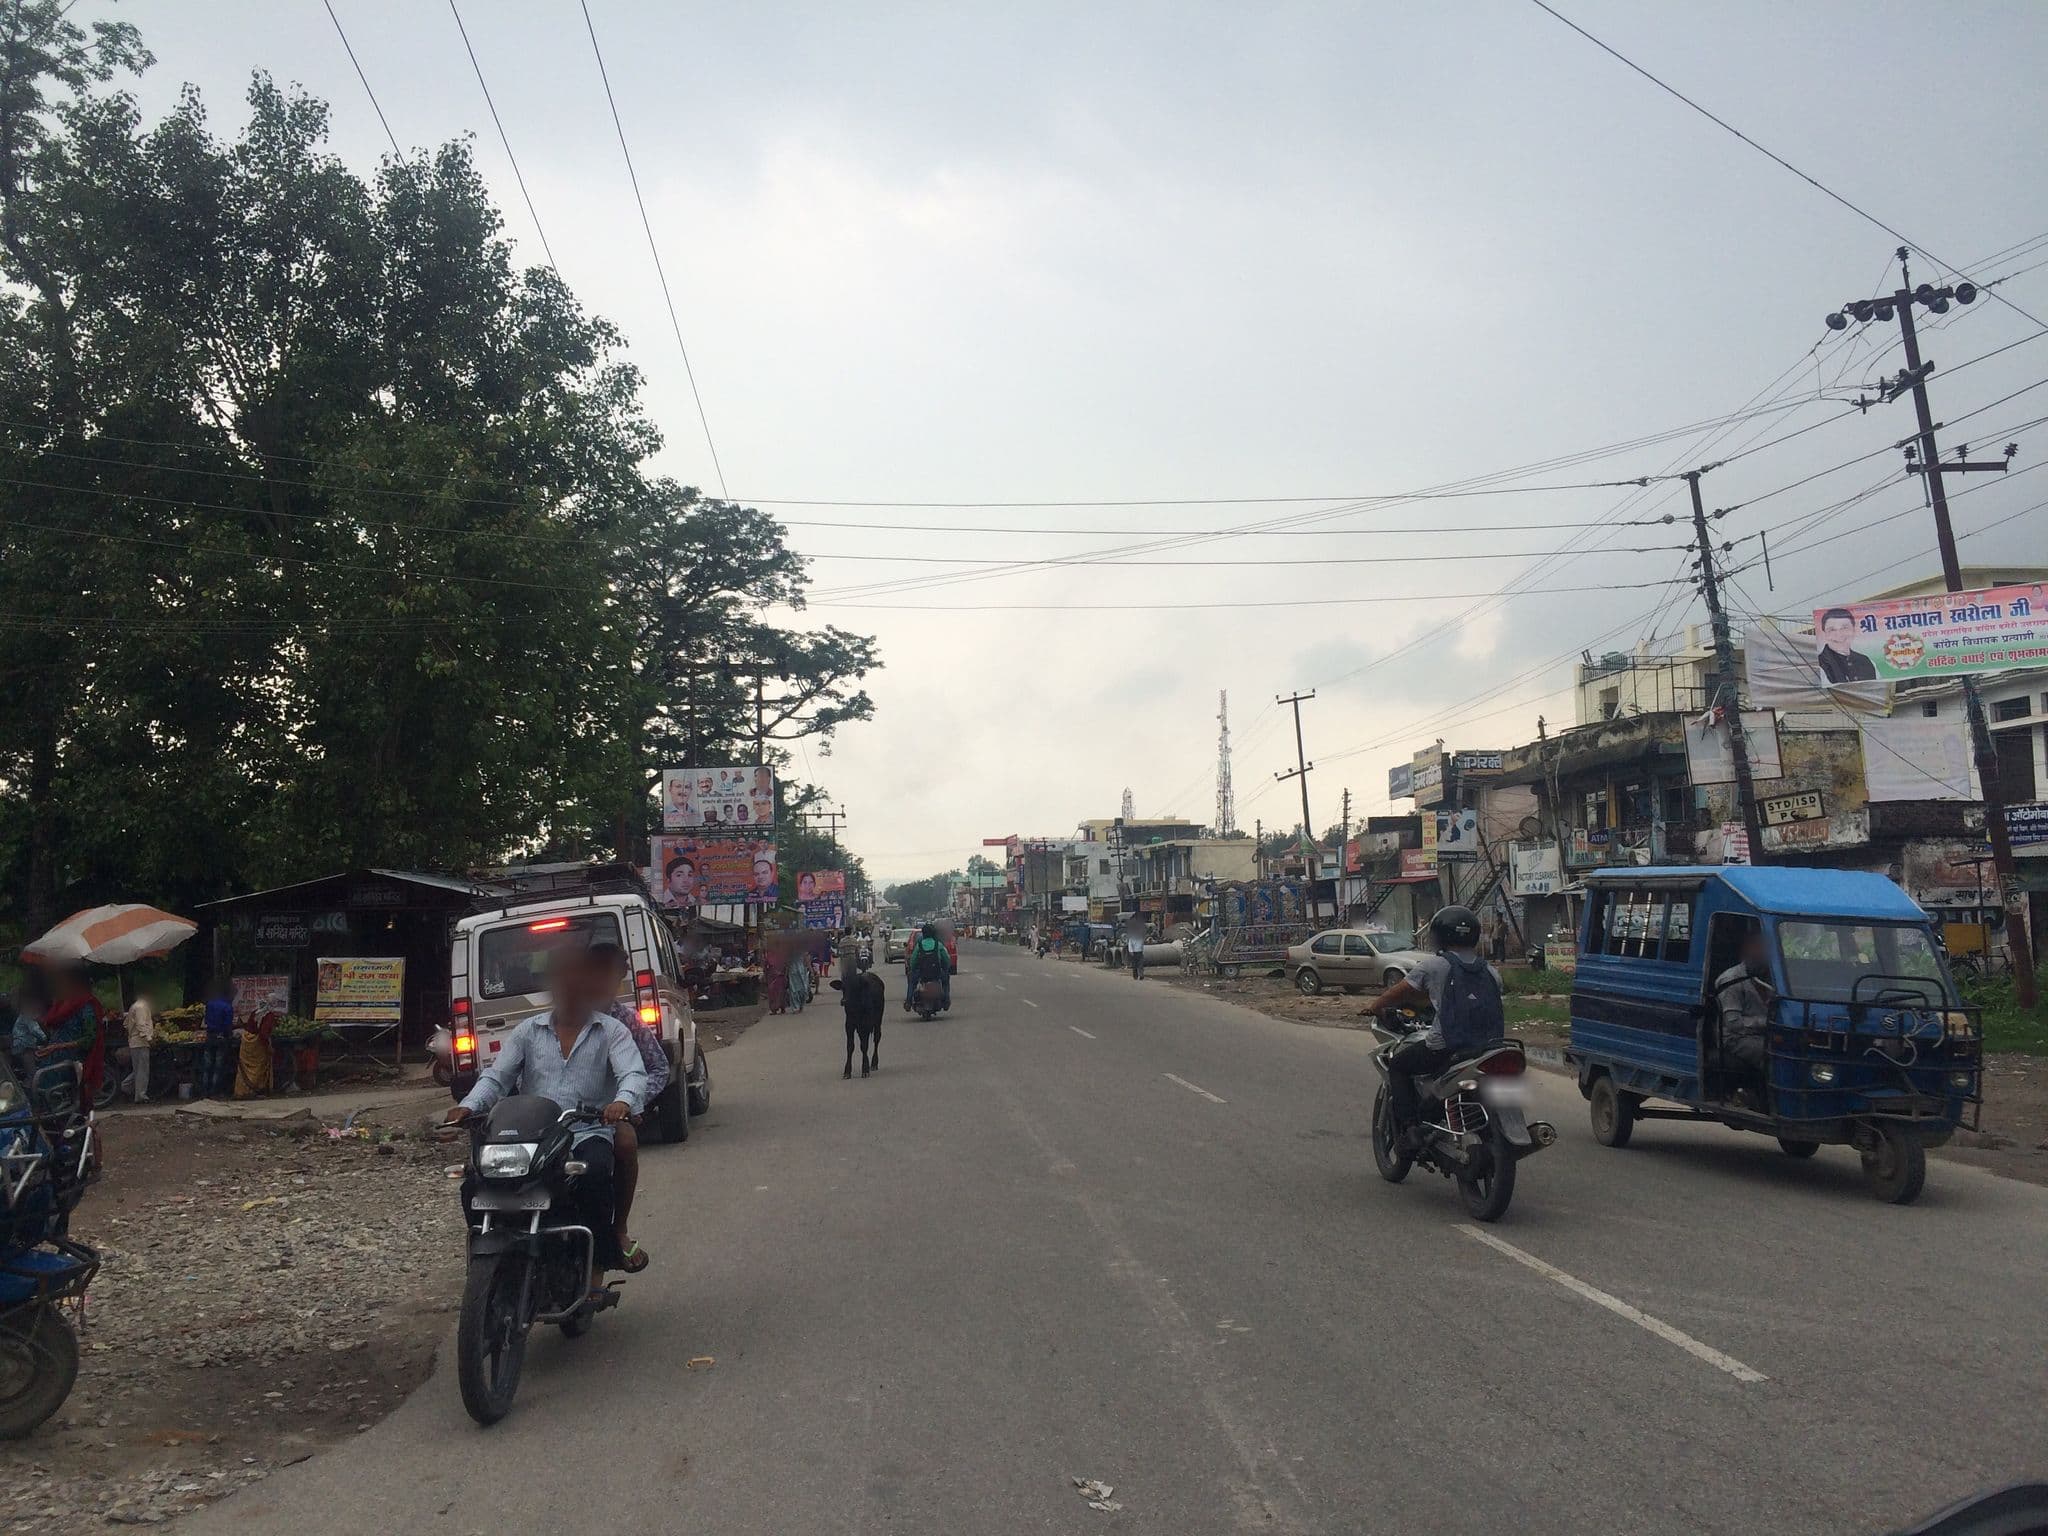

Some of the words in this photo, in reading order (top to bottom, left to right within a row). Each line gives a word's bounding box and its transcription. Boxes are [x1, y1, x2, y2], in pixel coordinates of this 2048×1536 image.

[1860, 614, 1878, 633] श्री
[1885, 610, 1943, 630] राजपाल
[1950, 603, 2002, 623] खरोला
[2009, 597, 2031, 617] जी
[1963, 634, 1998, 648] विधायक
[1767, 796, 1816, 811] STD/ISD
[1590, 834, 1608, 843] ATM
